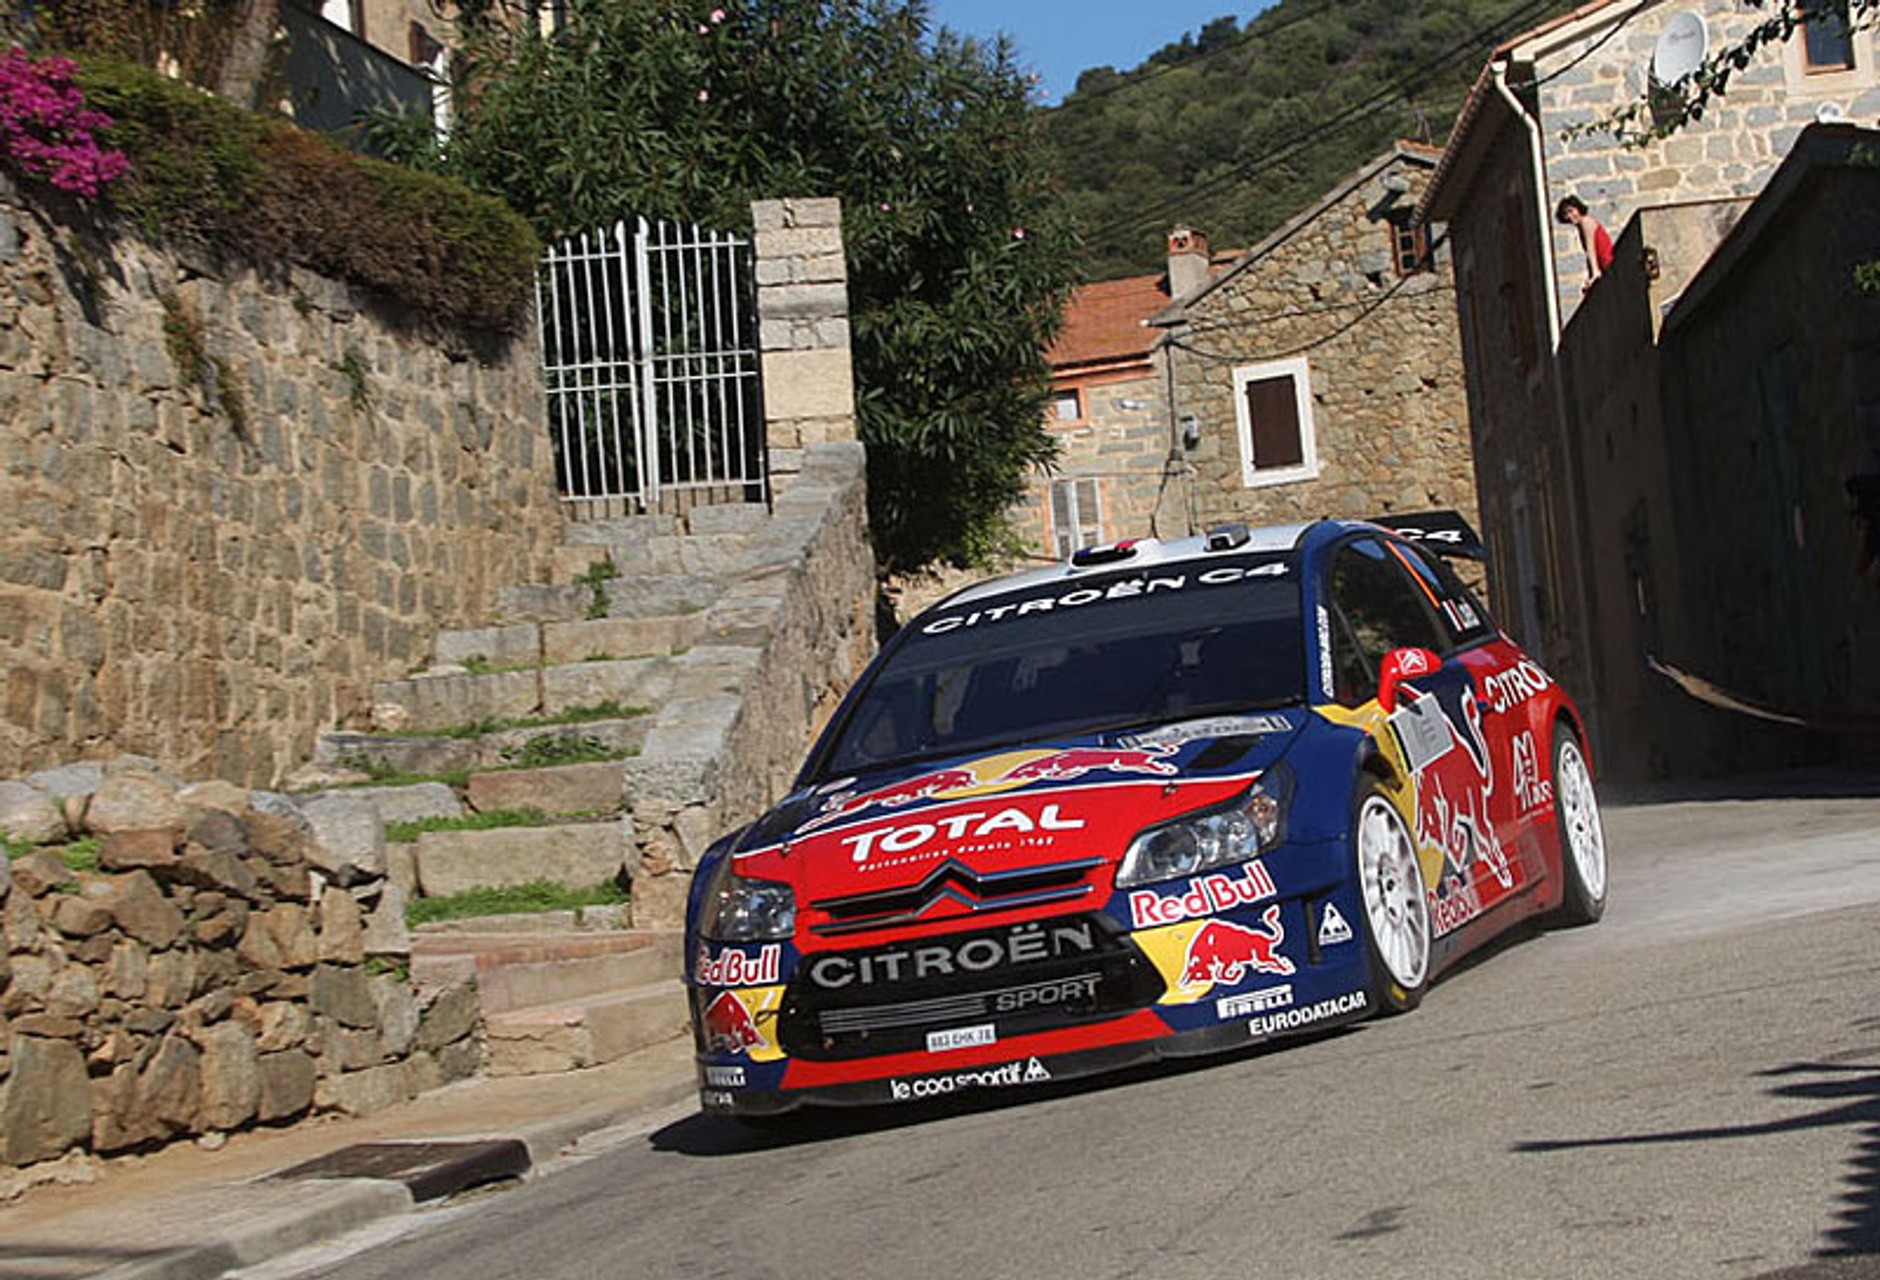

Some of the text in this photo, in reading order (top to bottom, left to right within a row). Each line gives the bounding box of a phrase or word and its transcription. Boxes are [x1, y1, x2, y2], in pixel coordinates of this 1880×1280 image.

[923, 562, 1290, 634] CITROËN C4
[841, 803, 1085, 862] TOTAL
[1129, 859, 1277, 928] Red Bull
[724, 943, 782, 985] Bull
[810, 922, 1094, 988] CITROËN
[995, 978, 1100, 1012] SPORT
[1216, 983, 1295, 1020] PIRELLI
[1249, 990, 1368, 1036] EURODATACAR
[890, 1079, 911, 1100] le
